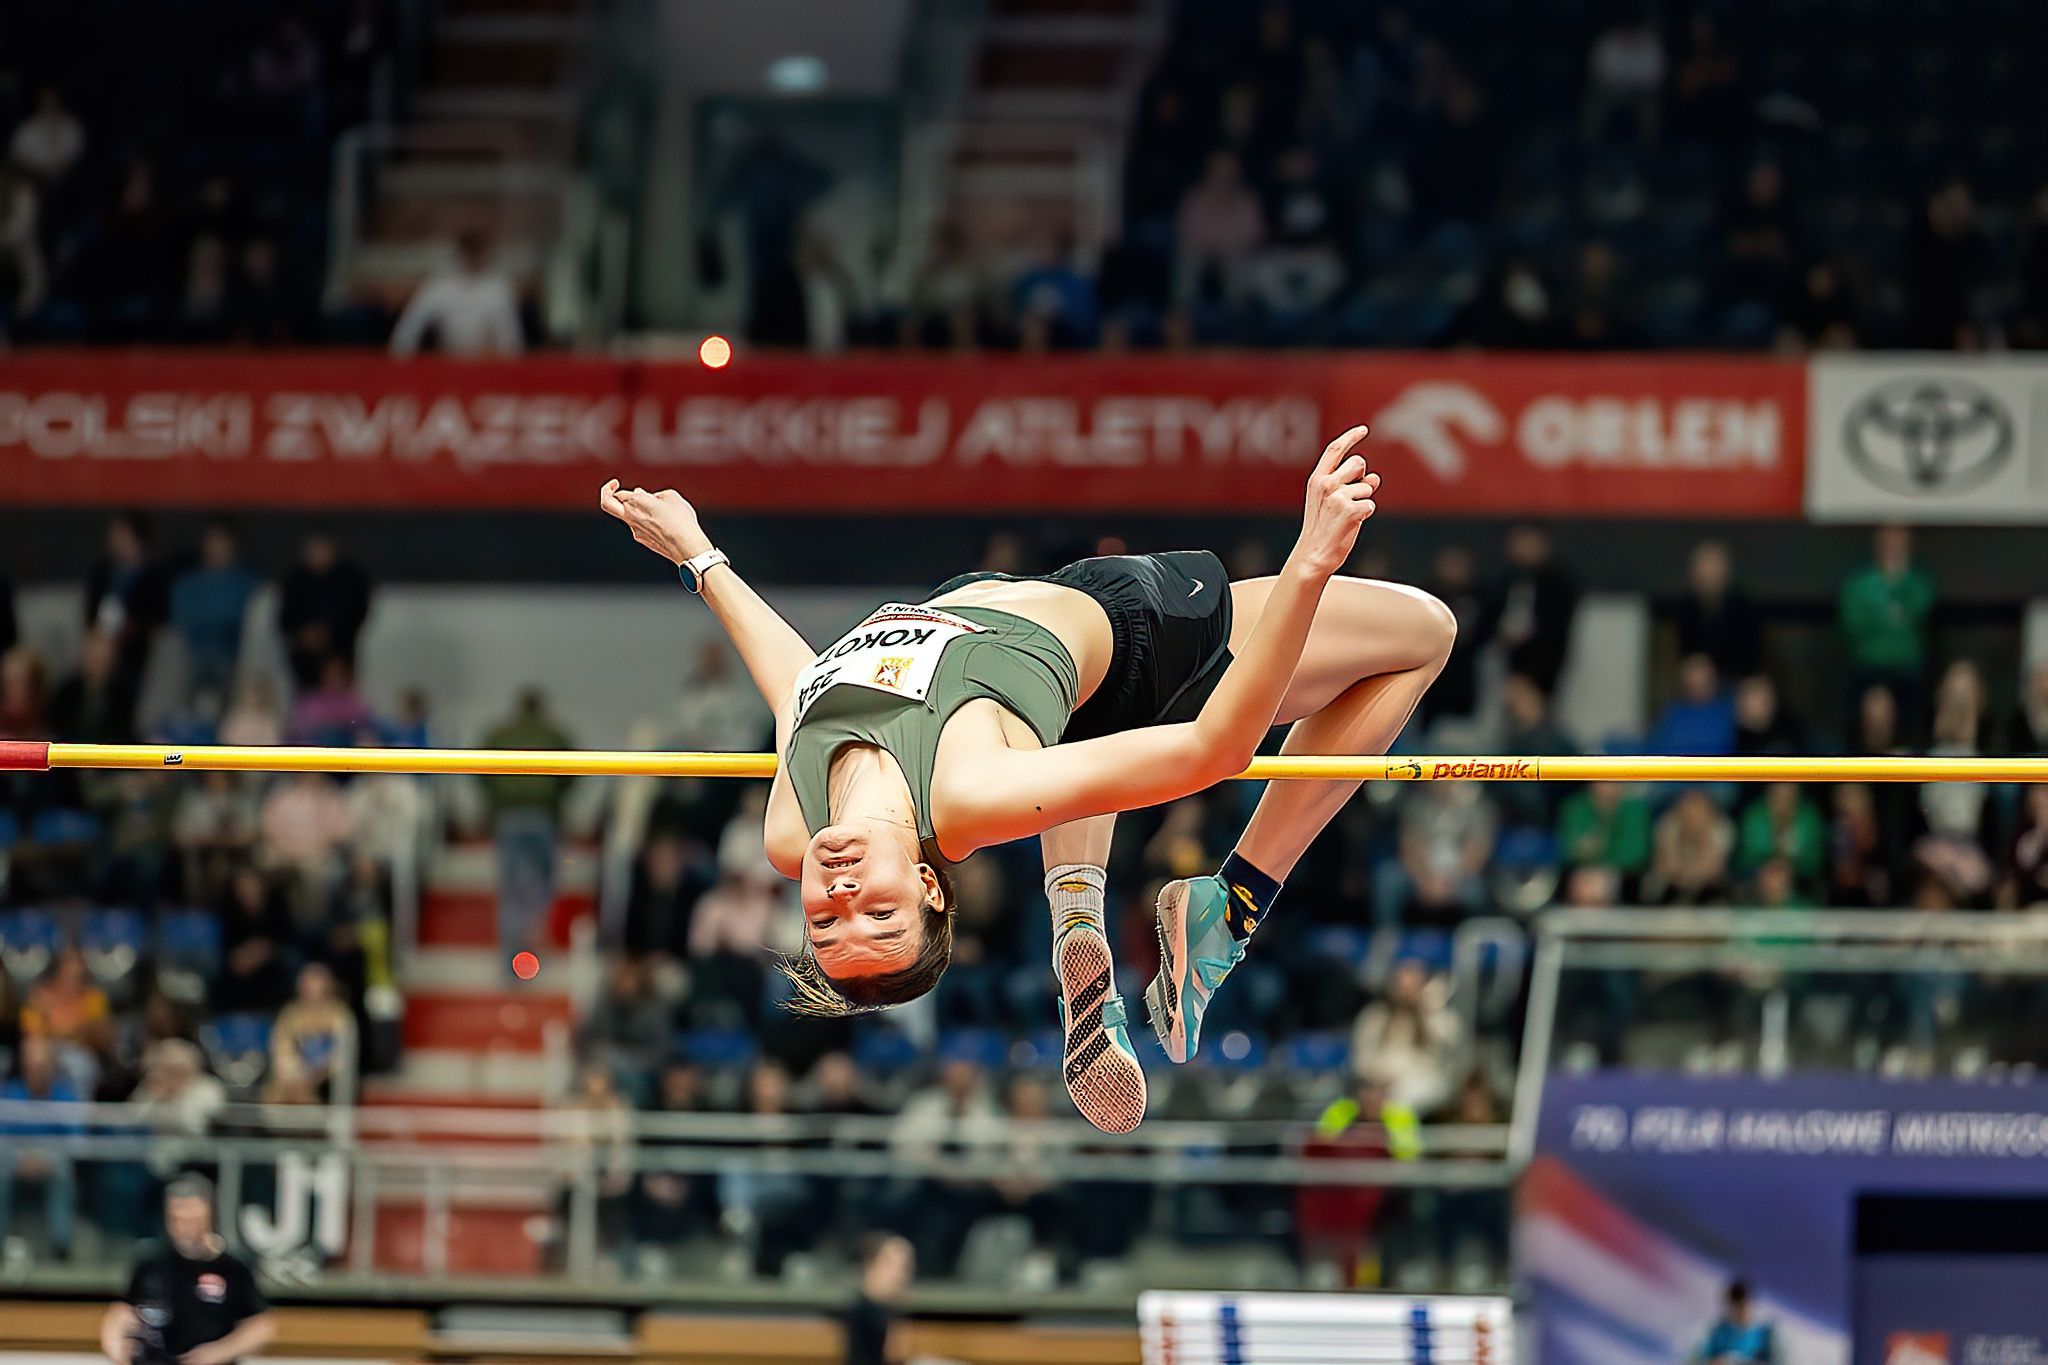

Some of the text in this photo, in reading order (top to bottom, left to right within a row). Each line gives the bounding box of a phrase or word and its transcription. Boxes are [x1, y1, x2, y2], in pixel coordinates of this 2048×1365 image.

[1517, 398, 1783, 467] ORLEN
[815, 628, 936, 668] KOKOT
[799, 667, 841, 712] 254
